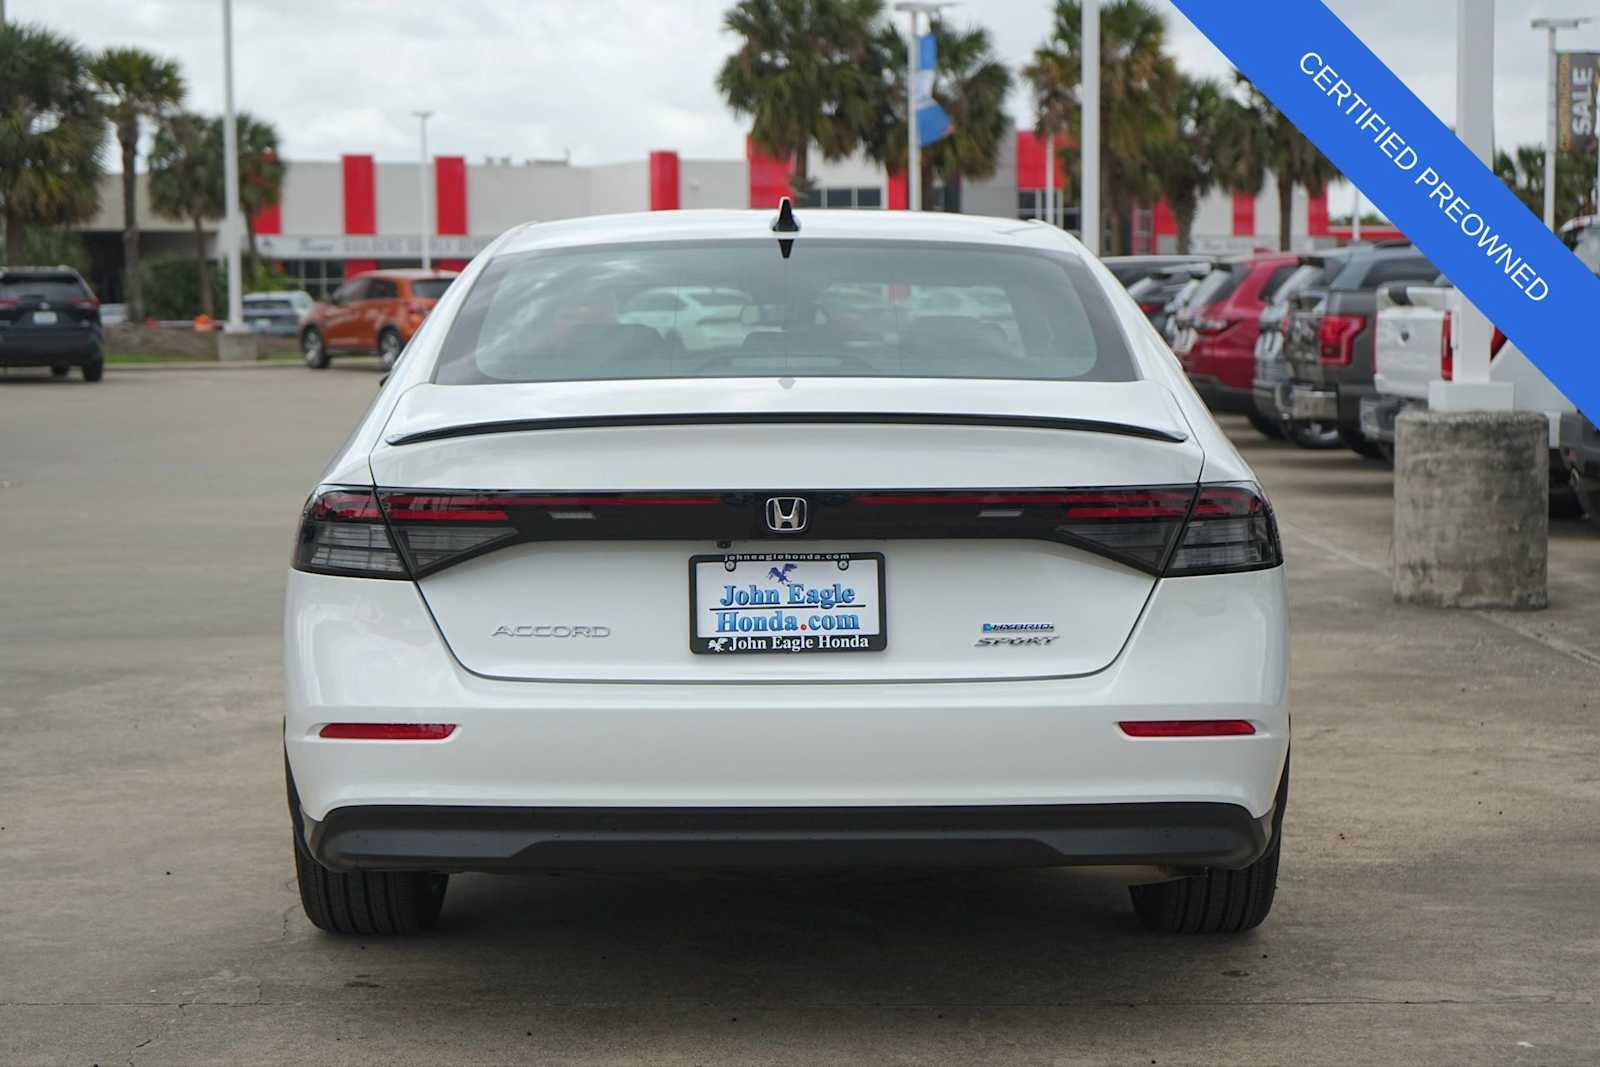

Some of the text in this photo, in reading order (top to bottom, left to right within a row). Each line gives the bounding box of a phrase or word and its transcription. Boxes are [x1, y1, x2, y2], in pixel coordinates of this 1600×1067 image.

[1572, 66, 1592, 135] SALE
[720, 583, 856, 609] John Eagle
[491, 625, 611, 638] ACCORD
[715, 611, 860, 633] Honda.com
[728, 635, 869, 651] John Eagle Honda
[974, 636, 1060, 647] SPORT
